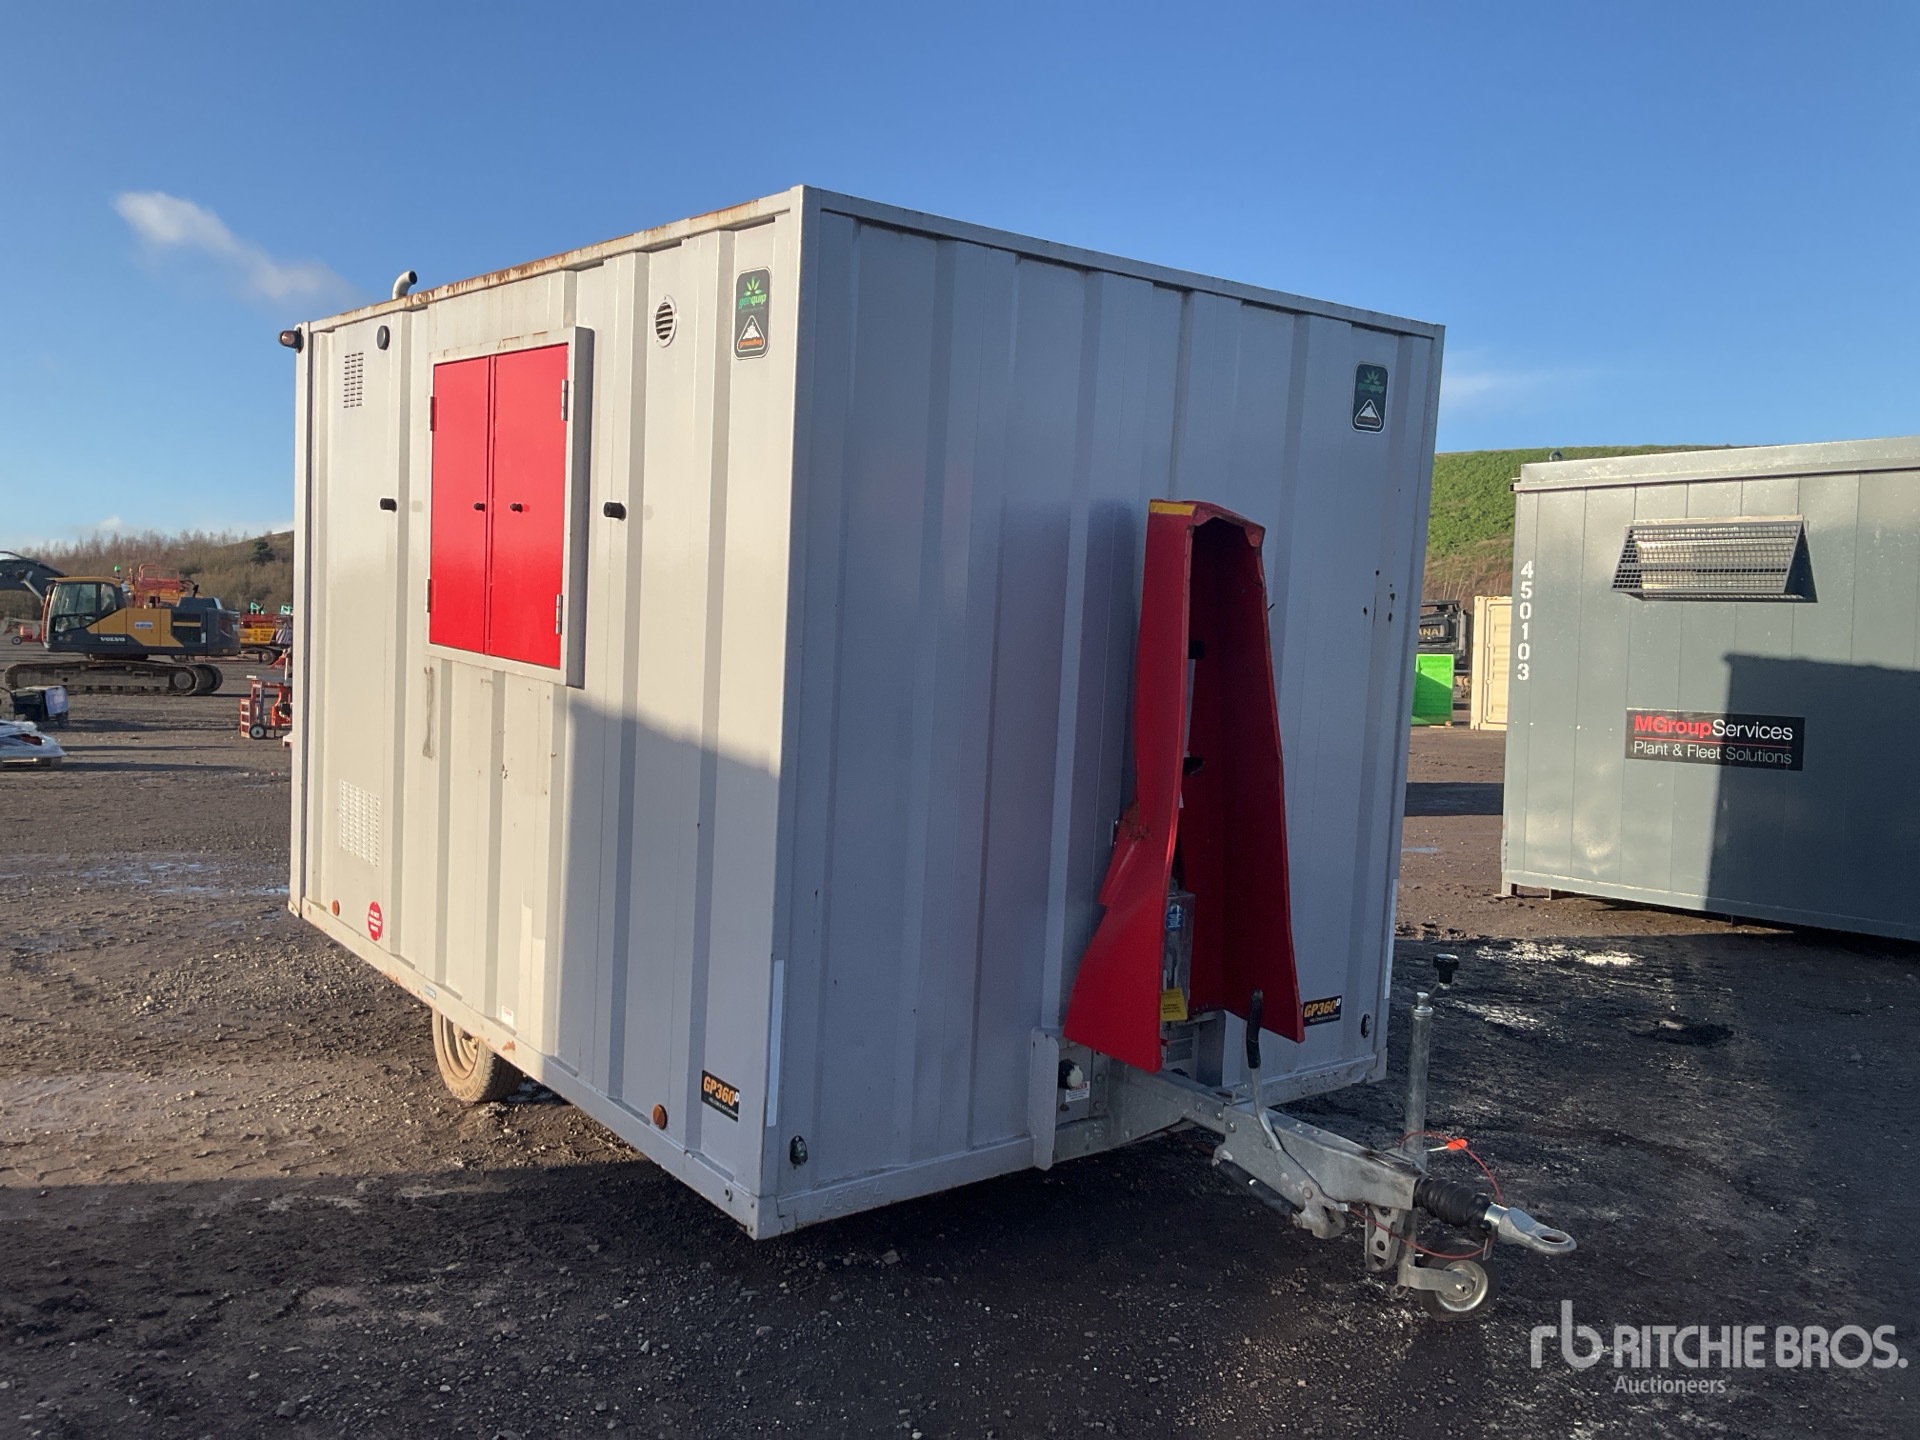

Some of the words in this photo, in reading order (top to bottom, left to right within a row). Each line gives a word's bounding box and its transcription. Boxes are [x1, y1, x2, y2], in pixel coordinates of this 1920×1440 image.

[1517, 560, 1534, 681] 450103
[1634, 714, 1794, 741] MGroupServices
[1634, 740, 1669, 757] Plant
[1673, 743, 1683, 757] &
[1687, 744, 1722, 761] Fleet
[1725, 747, 1793, 765] Solutions
